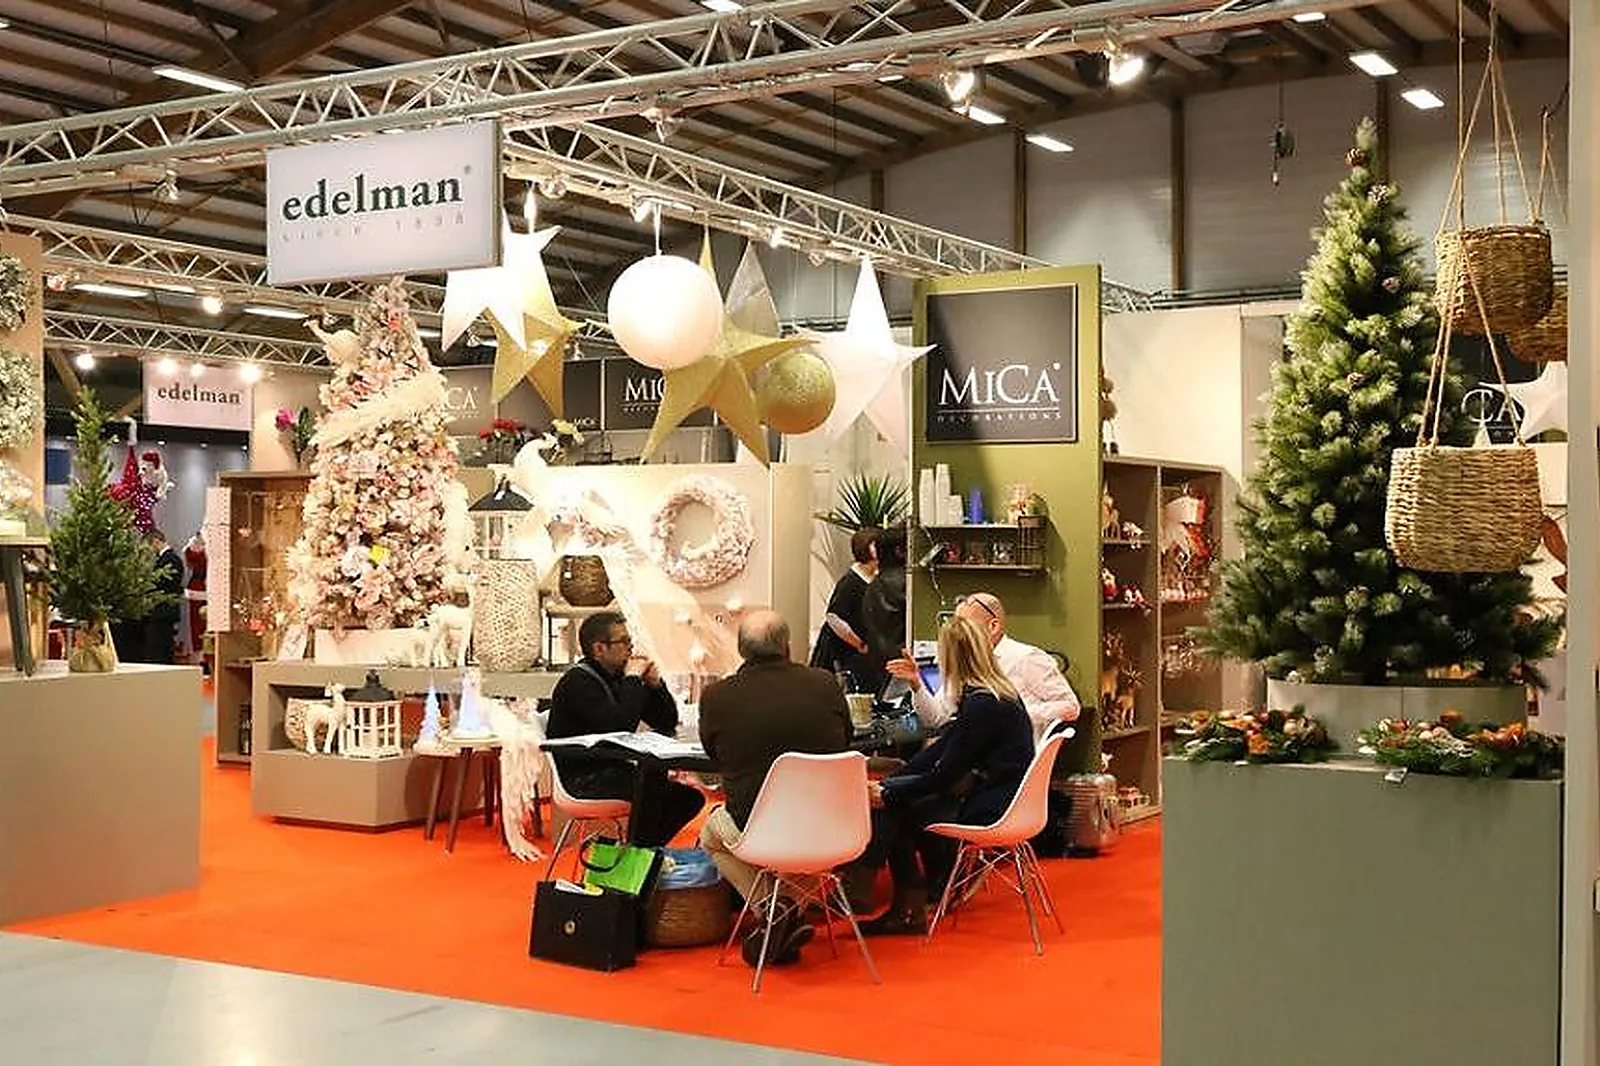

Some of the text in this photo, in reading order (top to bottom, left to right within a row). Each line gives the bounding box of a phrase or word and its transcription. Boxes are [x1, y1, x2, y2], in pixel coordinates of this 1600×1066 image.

[282, 173, 463, 221] edelman
[157, 382, 242, 404] edelman
[624, 376, 665, 401] MI
